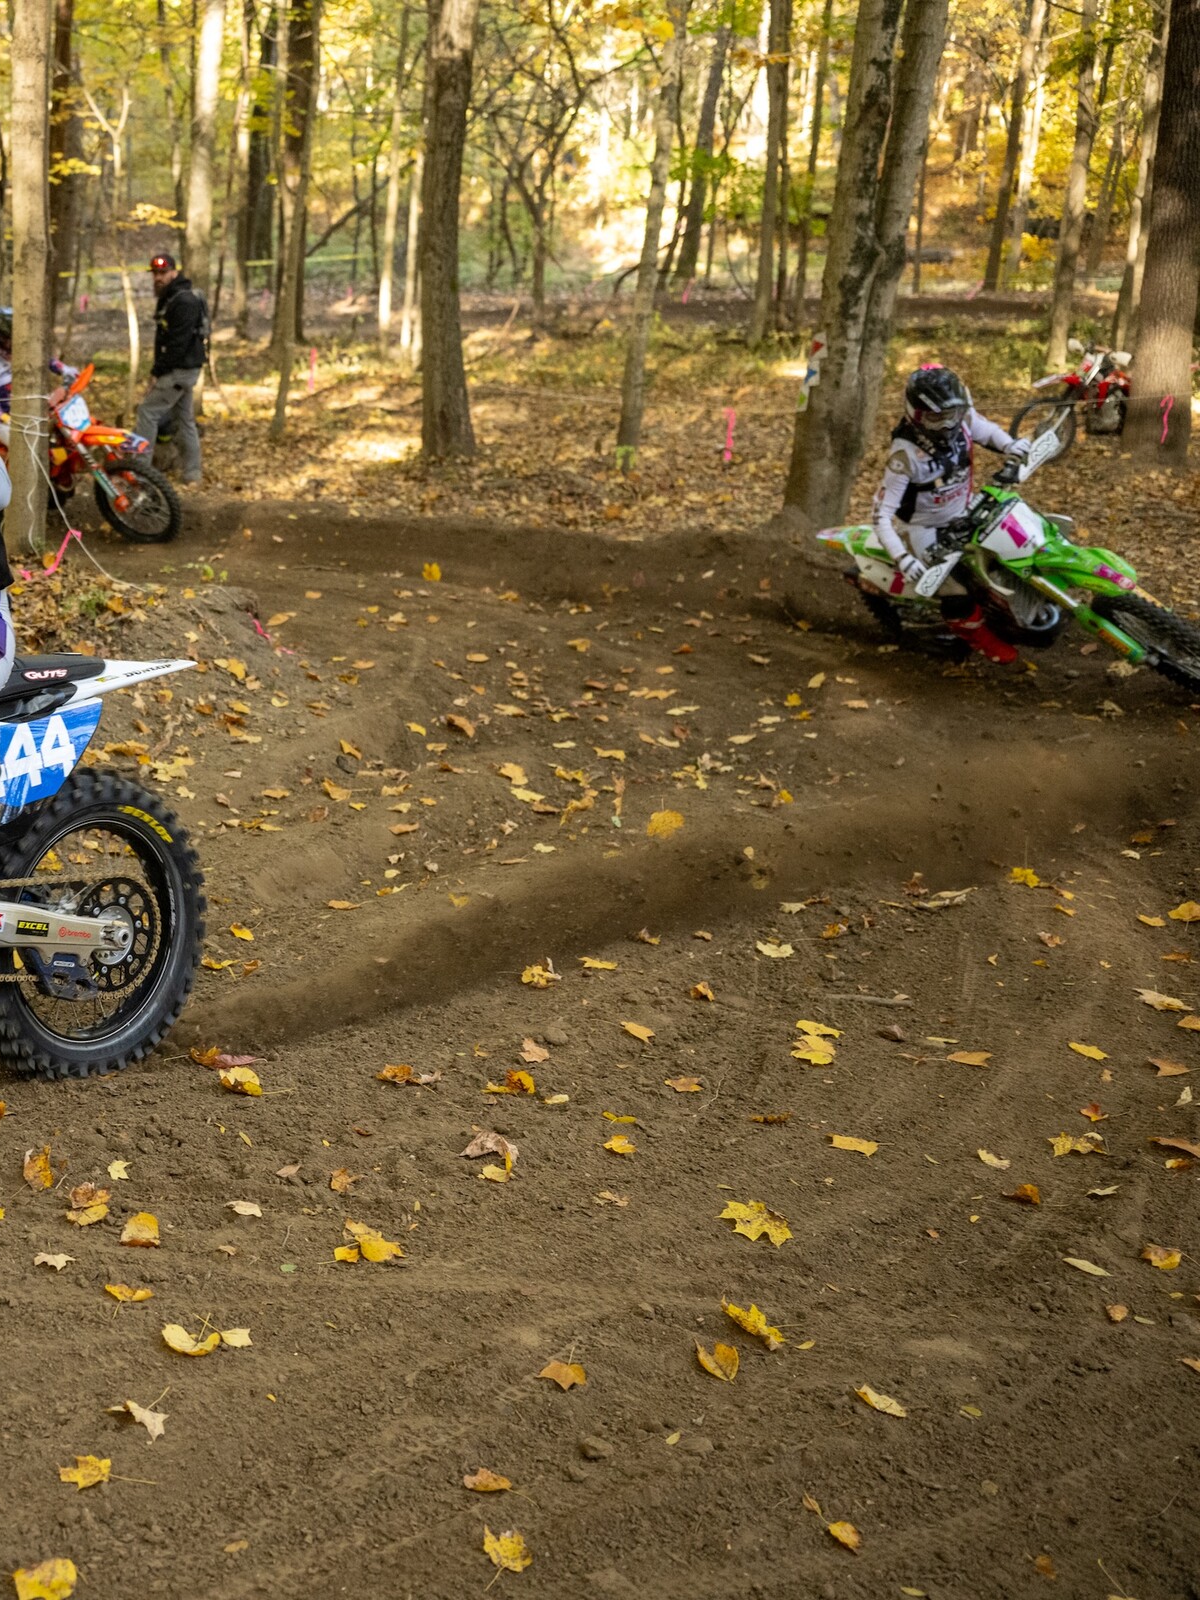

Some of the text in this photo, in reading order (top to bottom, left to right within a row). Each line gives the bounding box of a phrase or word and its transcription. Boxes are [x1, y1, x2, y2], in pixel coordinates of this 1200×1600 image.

[24, 668, 68, 680] GUTS
[124, 663, 172, 678] DUNLOP
[121, 805, 174, 843] DUNLOP
[18, 921, 49, 931] EXCEL
[67, 929, 92, 939] brembo
